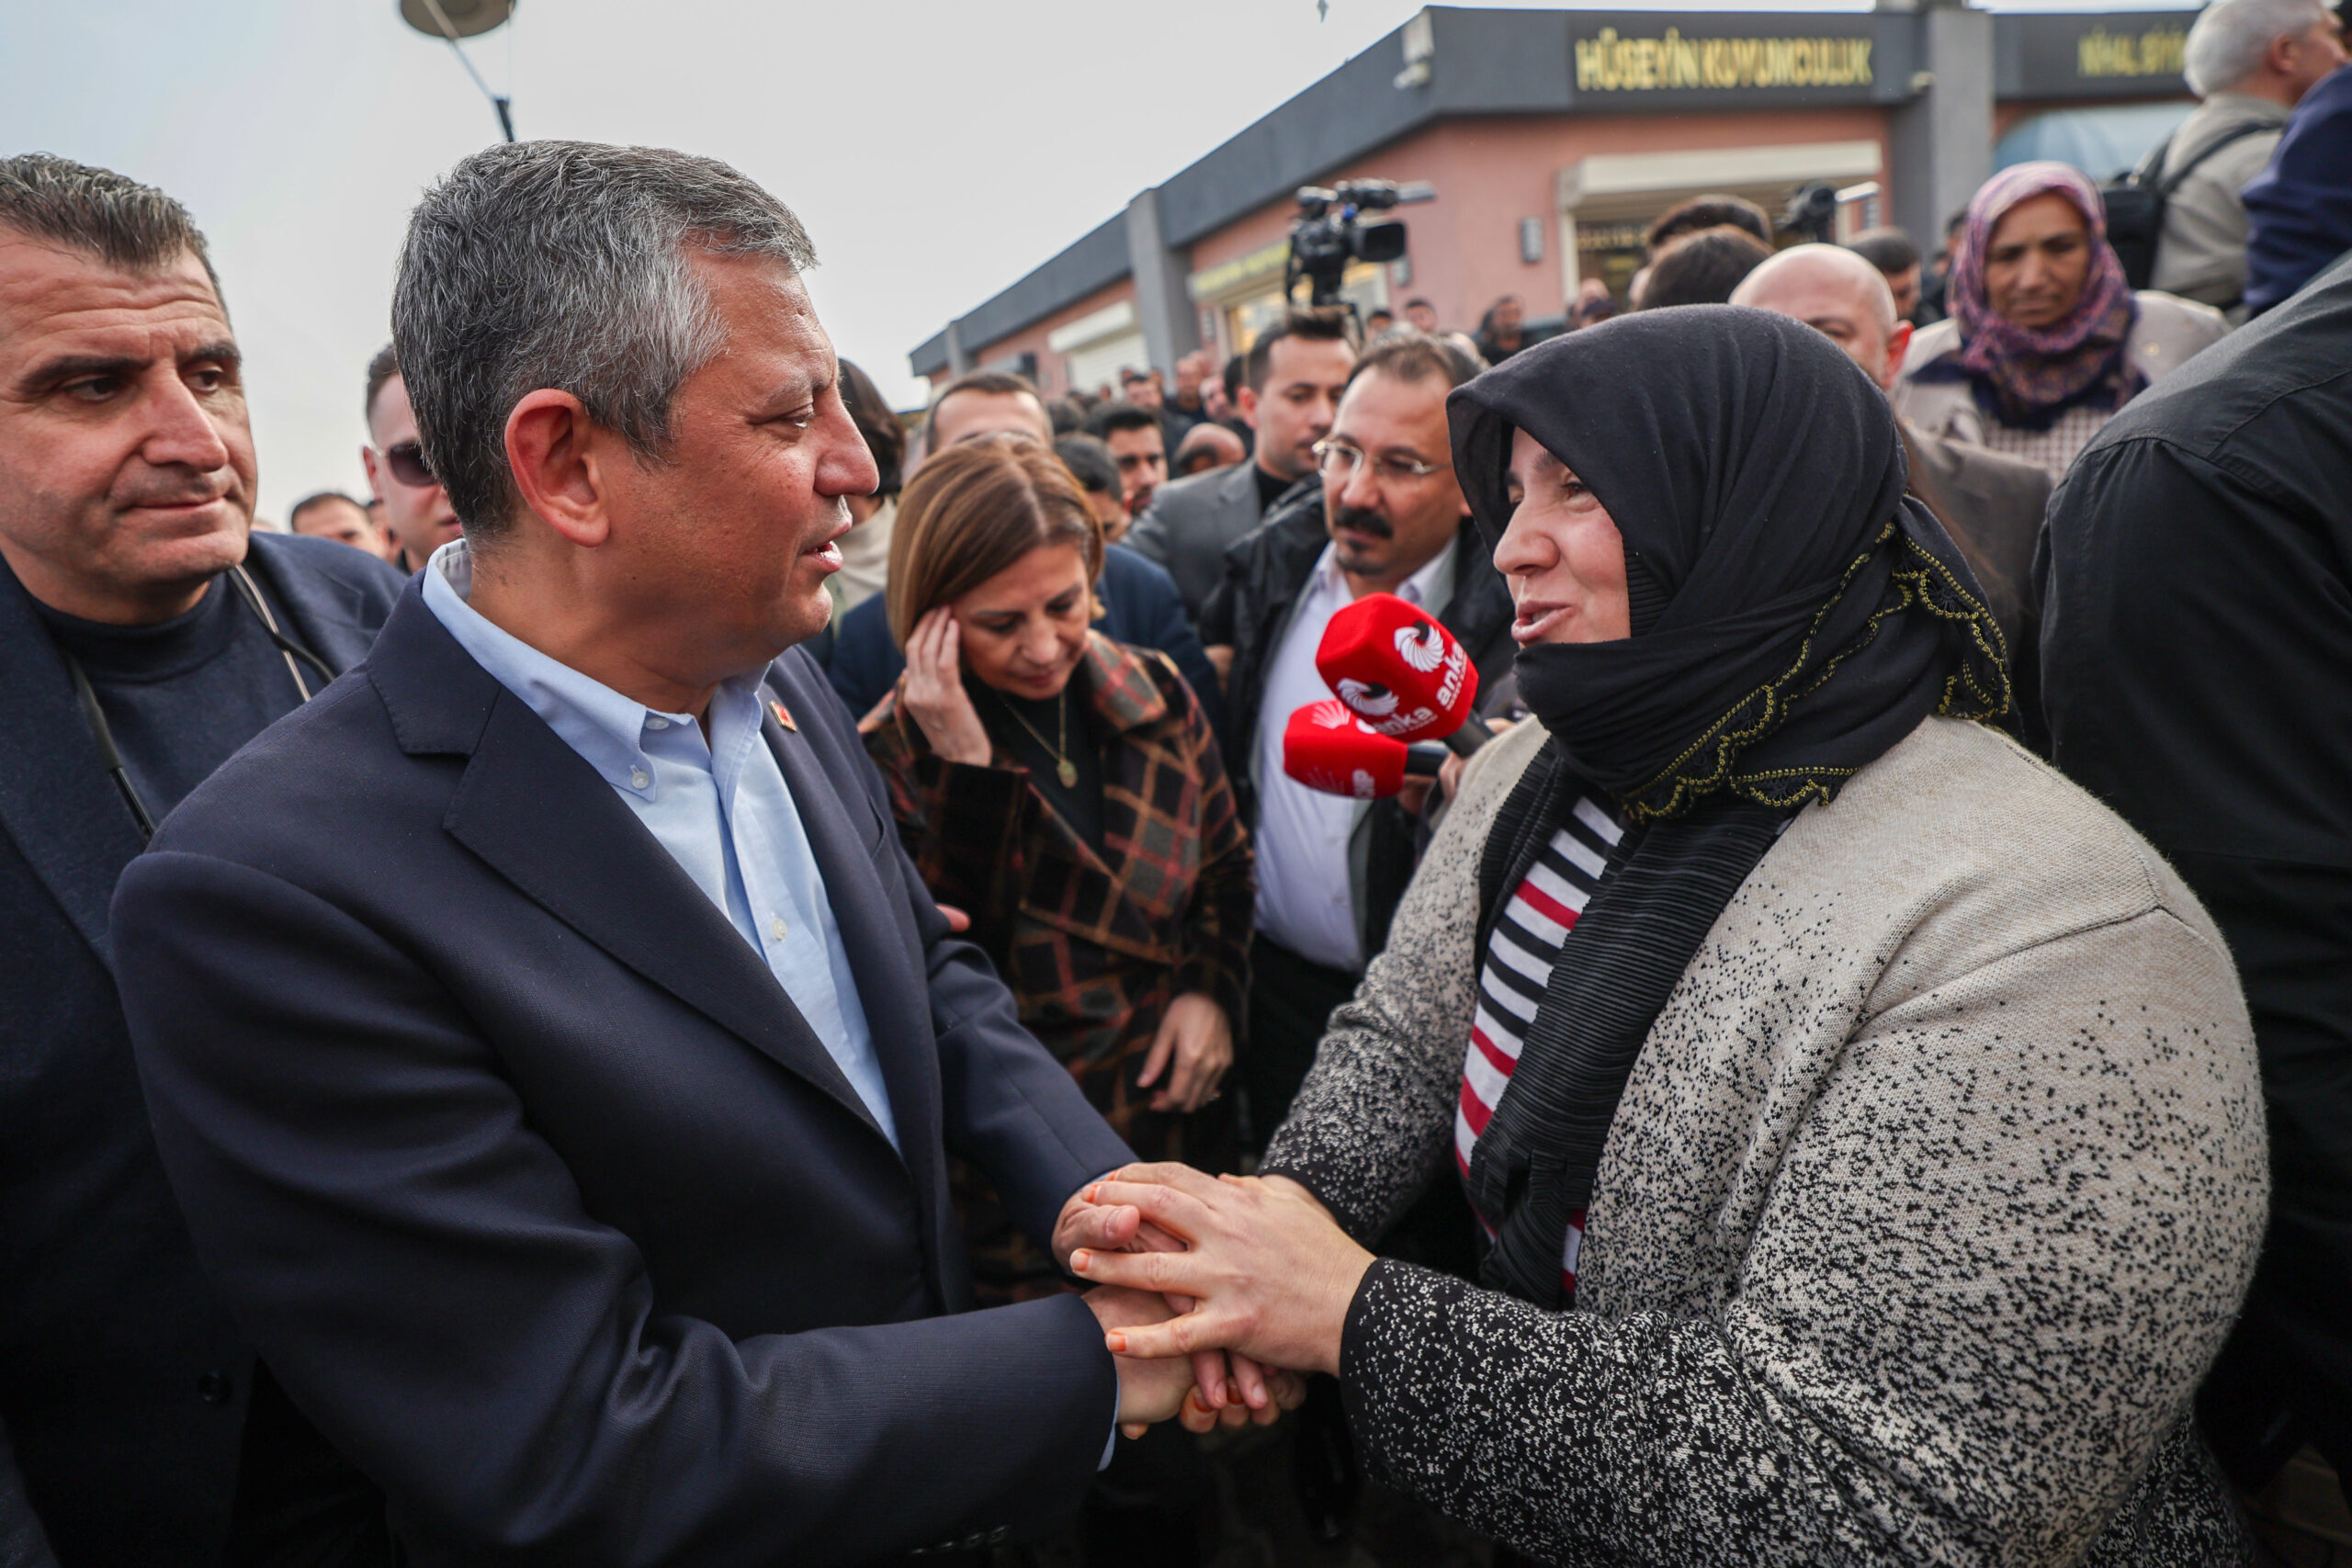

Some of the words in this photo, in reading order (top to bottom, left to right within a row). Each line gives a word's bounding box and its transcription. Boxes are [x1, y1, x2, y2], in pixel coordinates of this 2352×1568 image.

[1575, 27, 1699, 91] HÜSEYİN
[1700, 37, 1872, 88] KUYUMCULUK
[1436, 641, 1464, 706] anka
